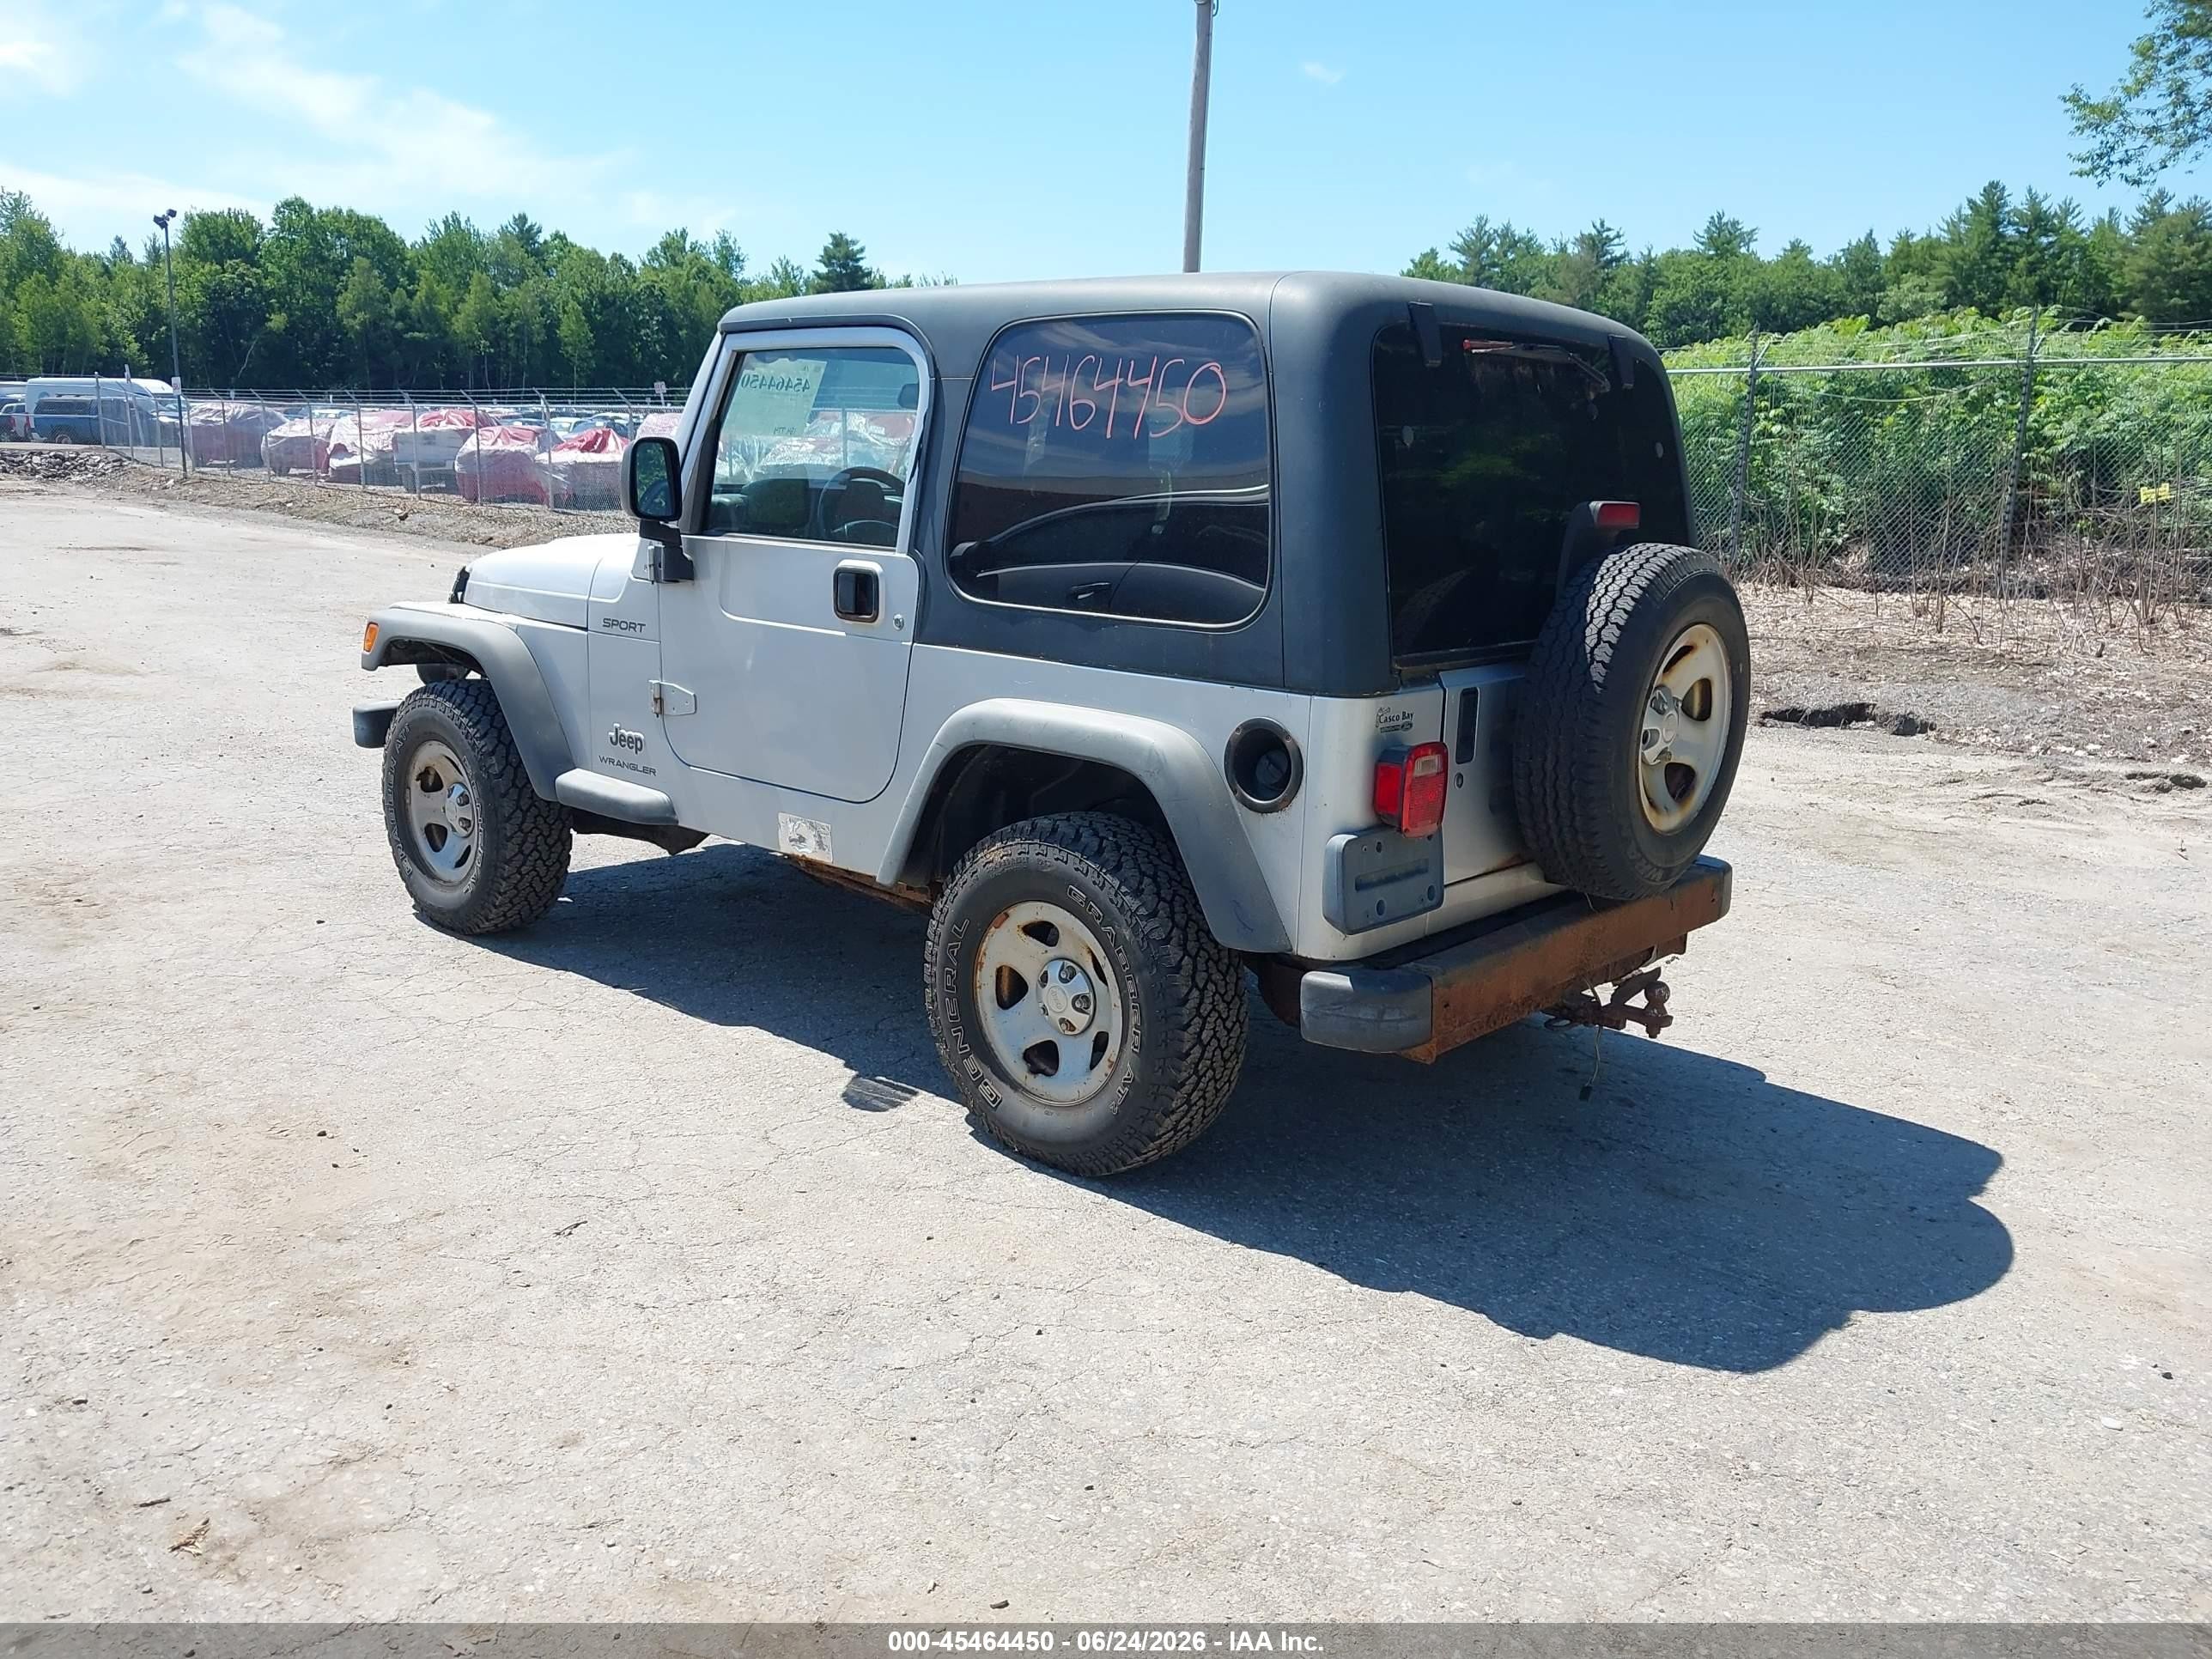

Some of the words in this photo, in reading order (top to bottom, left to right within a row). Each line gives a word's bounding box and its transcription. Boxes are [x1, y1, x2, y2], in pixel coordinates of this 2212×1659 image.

[991, 354, 1227, 439] 45464450
[603, 617, 646, 633] SPORT
[1378, 714, 1401, 724] Casco
[1401, 711, 1414, 721] Bay
[608, 722, 645, 756] Jeep
[599, 755, 657, 777] WRANGLER
[1068, 885, 1142, 1054] GRABBER
[944, 918, 1003, 1108] GENERAL
